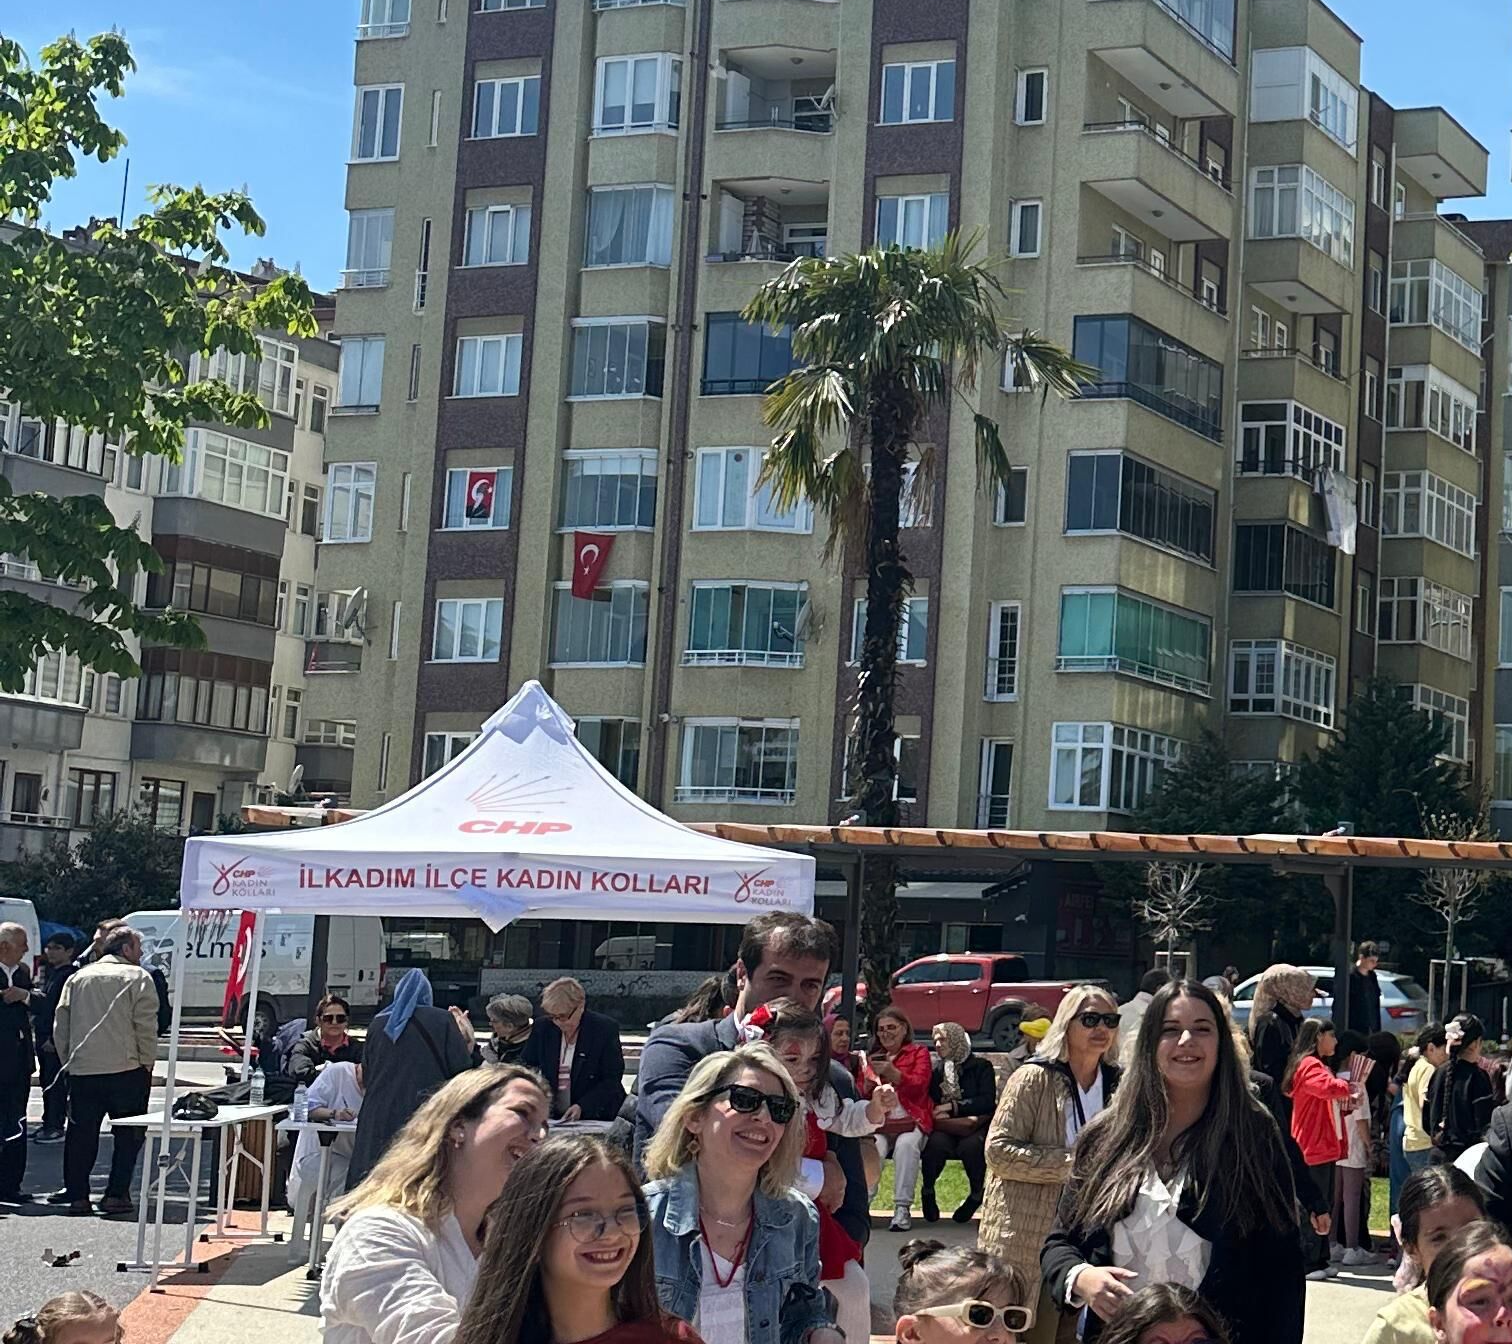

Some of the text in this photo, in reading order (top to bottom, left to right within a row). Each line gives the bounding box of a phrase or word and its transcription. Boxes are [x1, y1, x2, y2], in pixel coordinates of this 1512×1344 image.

[458, 819, 573, 835] CHP
[232, 869, 256, 879] CHP
[232, 879, 268, 888] KADIN
[299, 863, 710, 895] İLKADIM İLÇE KADIN KOLLARI
[753, 879, 775, 888] CHP
[231, 888, 276, 897] KOLLARI
[752, 888, 785, 897] KADIN
[750, 896, 792, 907] KOLLARI
